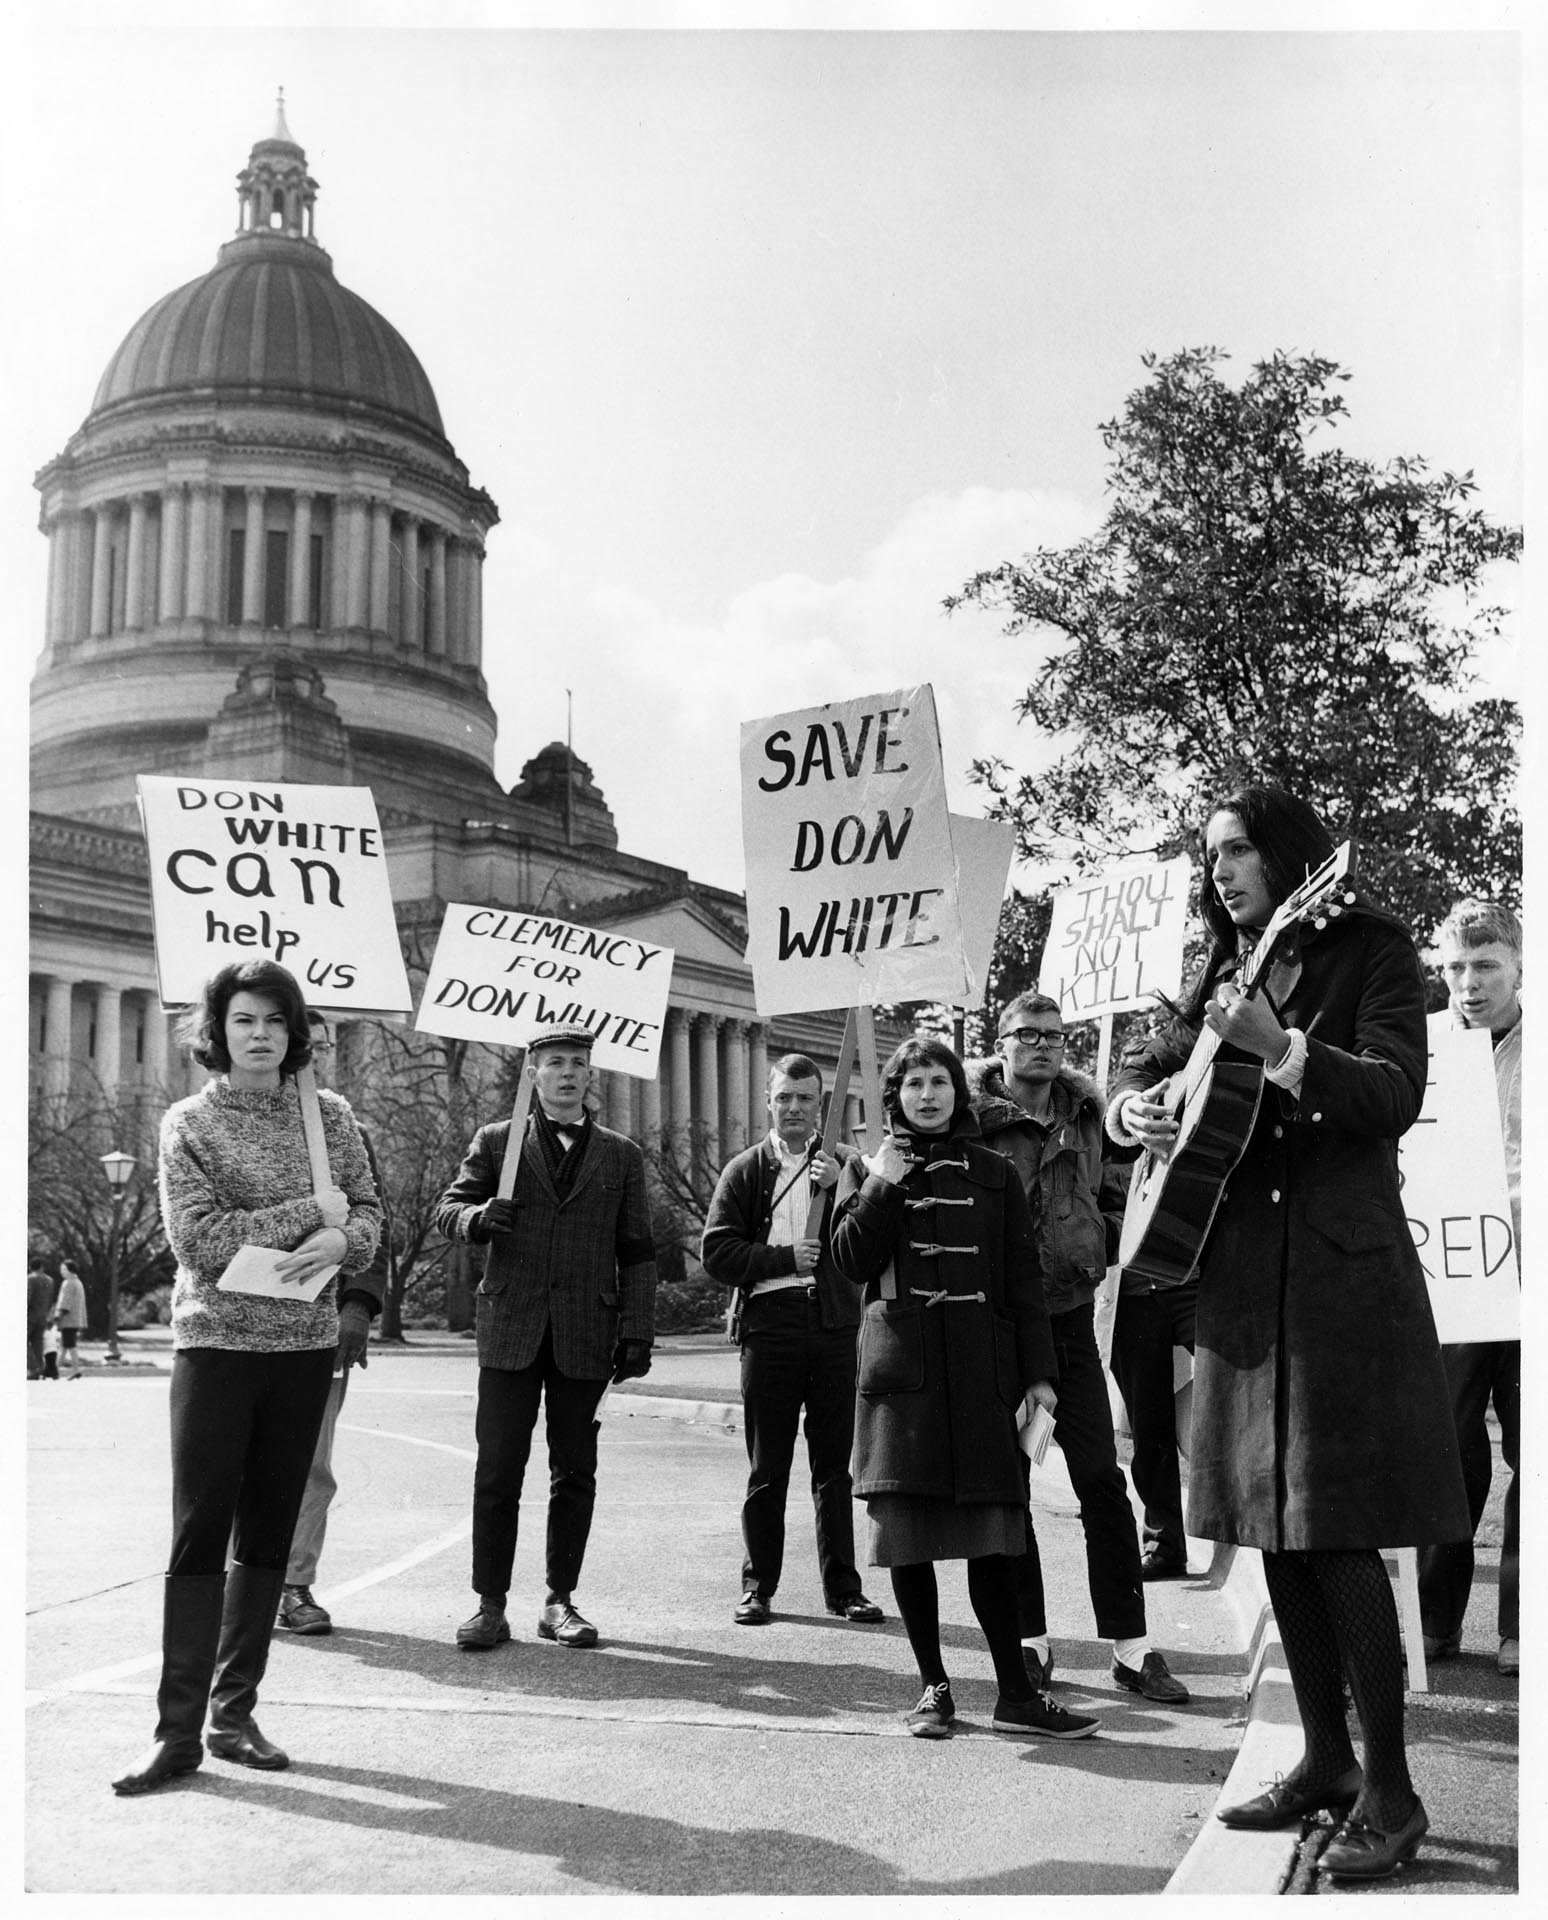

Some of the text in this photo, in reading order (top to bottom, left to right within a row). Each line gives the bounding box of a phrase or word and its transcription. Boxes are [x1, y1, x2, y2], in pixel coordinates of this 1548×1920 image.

[758, 708, 910, 792] SAVE
[176, 786, 284, 813] DON
[225, 816, 379, 857] WHITE
[789, 807, 914, 872] DON
[166, 848, 345, 908] can
[1077, 869, 1169, 921] THOU
[206, 911, 300, 962] help
[465, 911, 662, 972] CLEMENCY
[778, 888, 945, 961] WHITE
[1061, 896, 1175, 949] SHALT
[307, 957, 358, 990] us
[504, 955, 582, 987] FOR
[1074, 930, 1143, 977] NOT
[1059, 961, 1156, 1012] KILL
[433, 977, 660, 1052] DON WHITE
